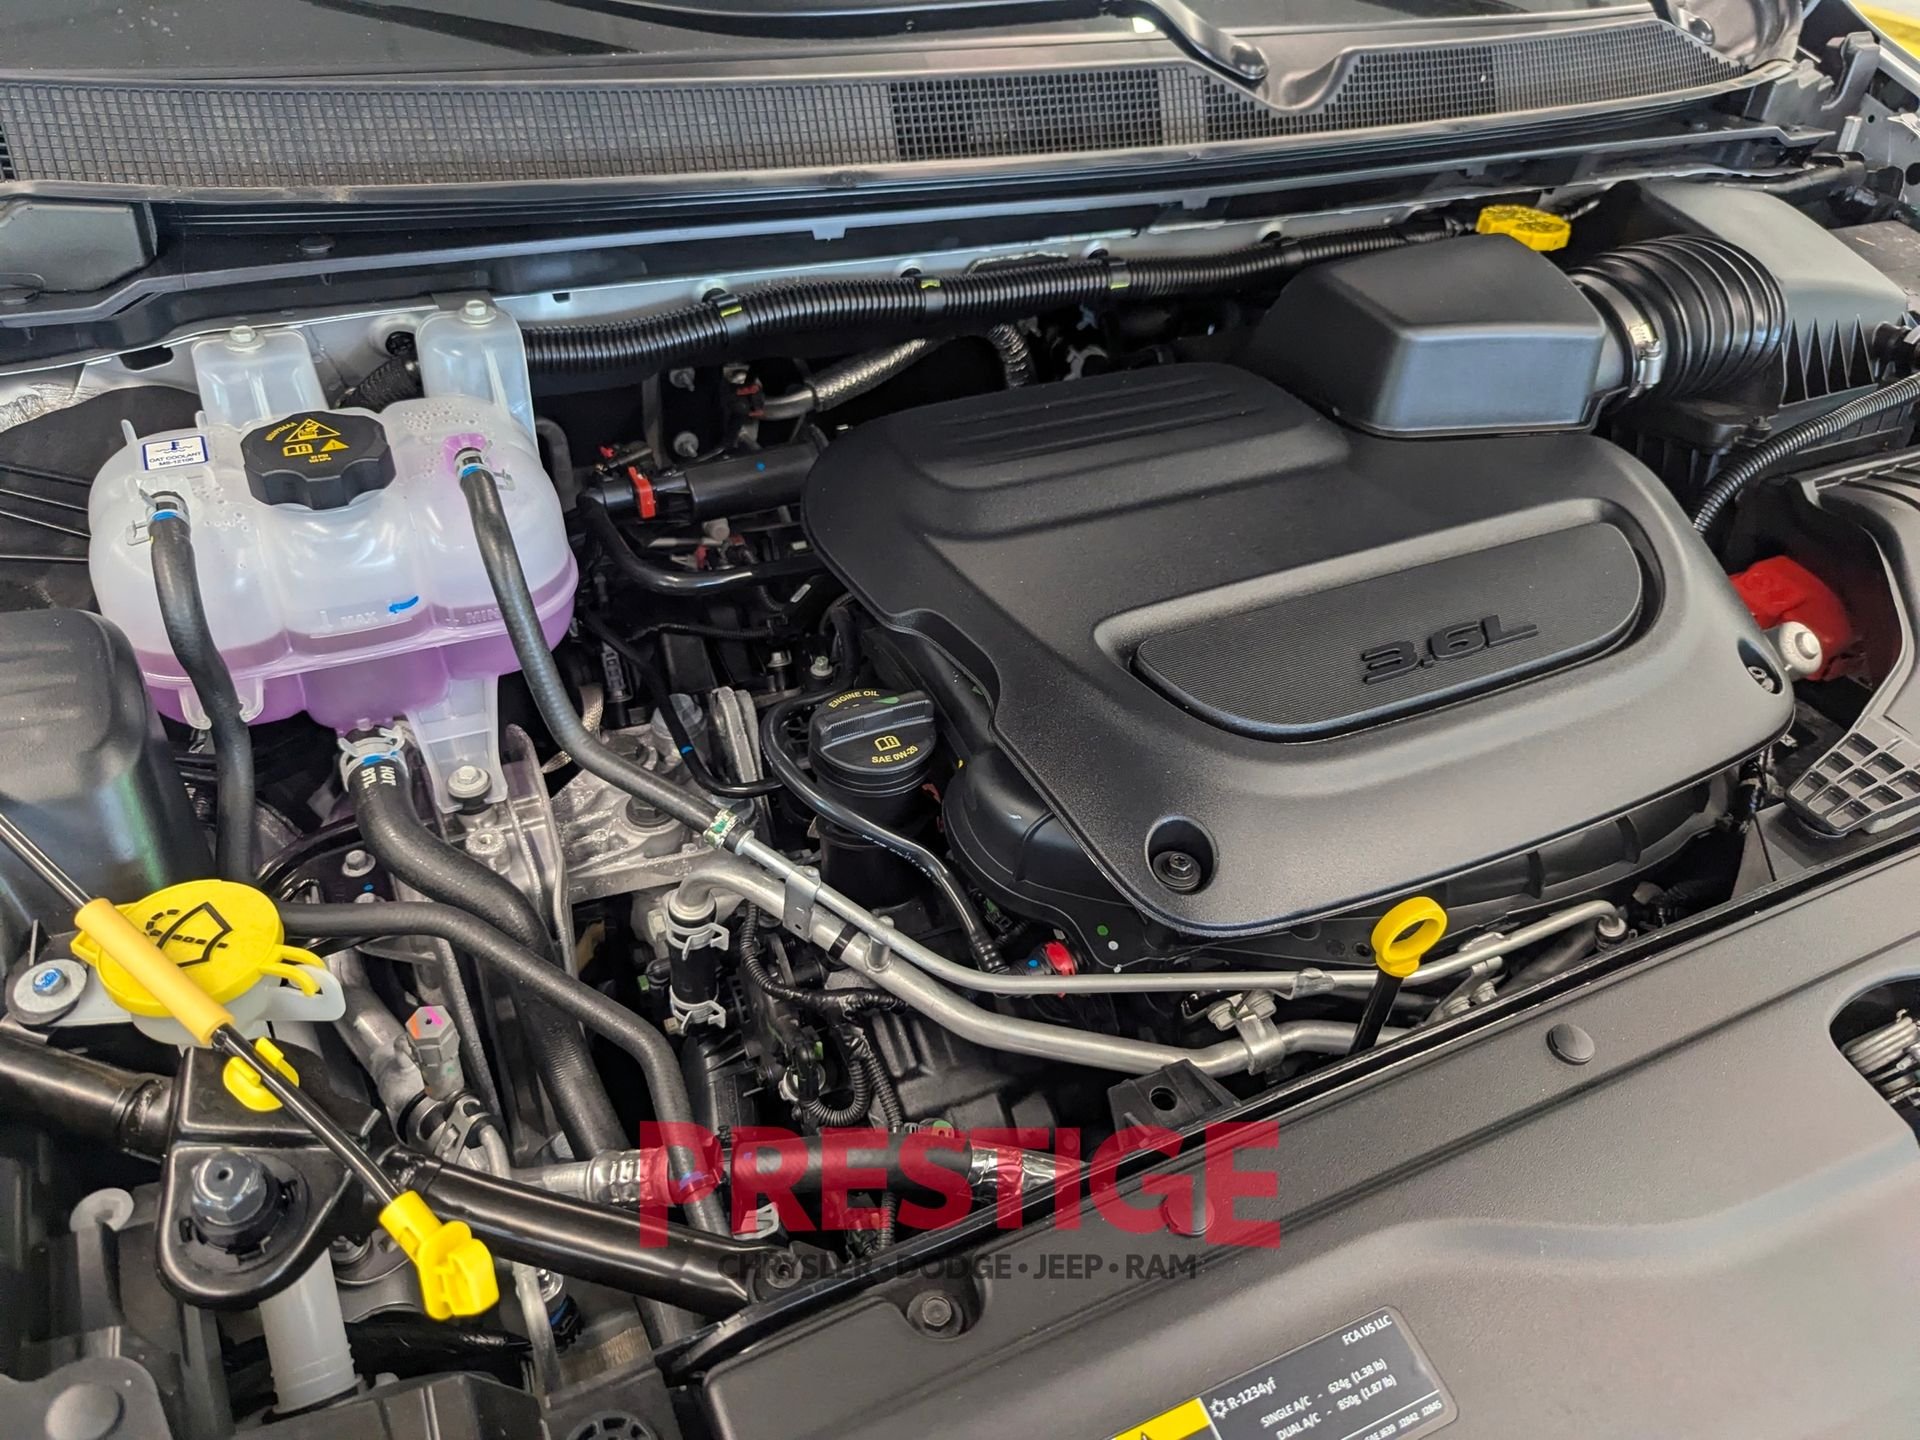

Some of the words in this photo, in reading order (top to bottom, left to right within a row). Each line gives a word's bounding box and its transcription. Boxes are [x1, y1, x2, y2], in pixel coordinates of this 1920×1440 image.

[165, 452, 201, 461] COOLANT
[340, 611, 378, 628] MAX
[465, 608, 499, 625] MIN
[1360, 614, 1540, 686] 3.6L
[828, 690, 862, 708] ENGINE
[871, 755, 893, 764] SAE
[893, 745, 918, 762] 0W-20
[361, 767, 377, 789] BTL
[379, 765, 397, 786] HOT
[1341, 1329, 1363, 1346] FCA
[1360, 1322, 1376, 1336] US
[1374, 1315, 1392, 1330] LLC
[1226, 1376, 1277, 1410] R-1234yf
[1260, 1404, 1294, 1429] SINGLE
[1293, 1395, 1312, 1412] A/C
[1328, 1378, 1352, 1394] 624g
[1351, 1364, 1375, 1384] (1.38
[1372, 1358, 1388, 1371] lb)
[1276, 1422, 1304, 1440] DUAL
[1302, 1412, 1321, 1427] A/C
[1360, 1381, 1382, 1400] (1.87
[1381, 1374, 1397, 1388] lb)
